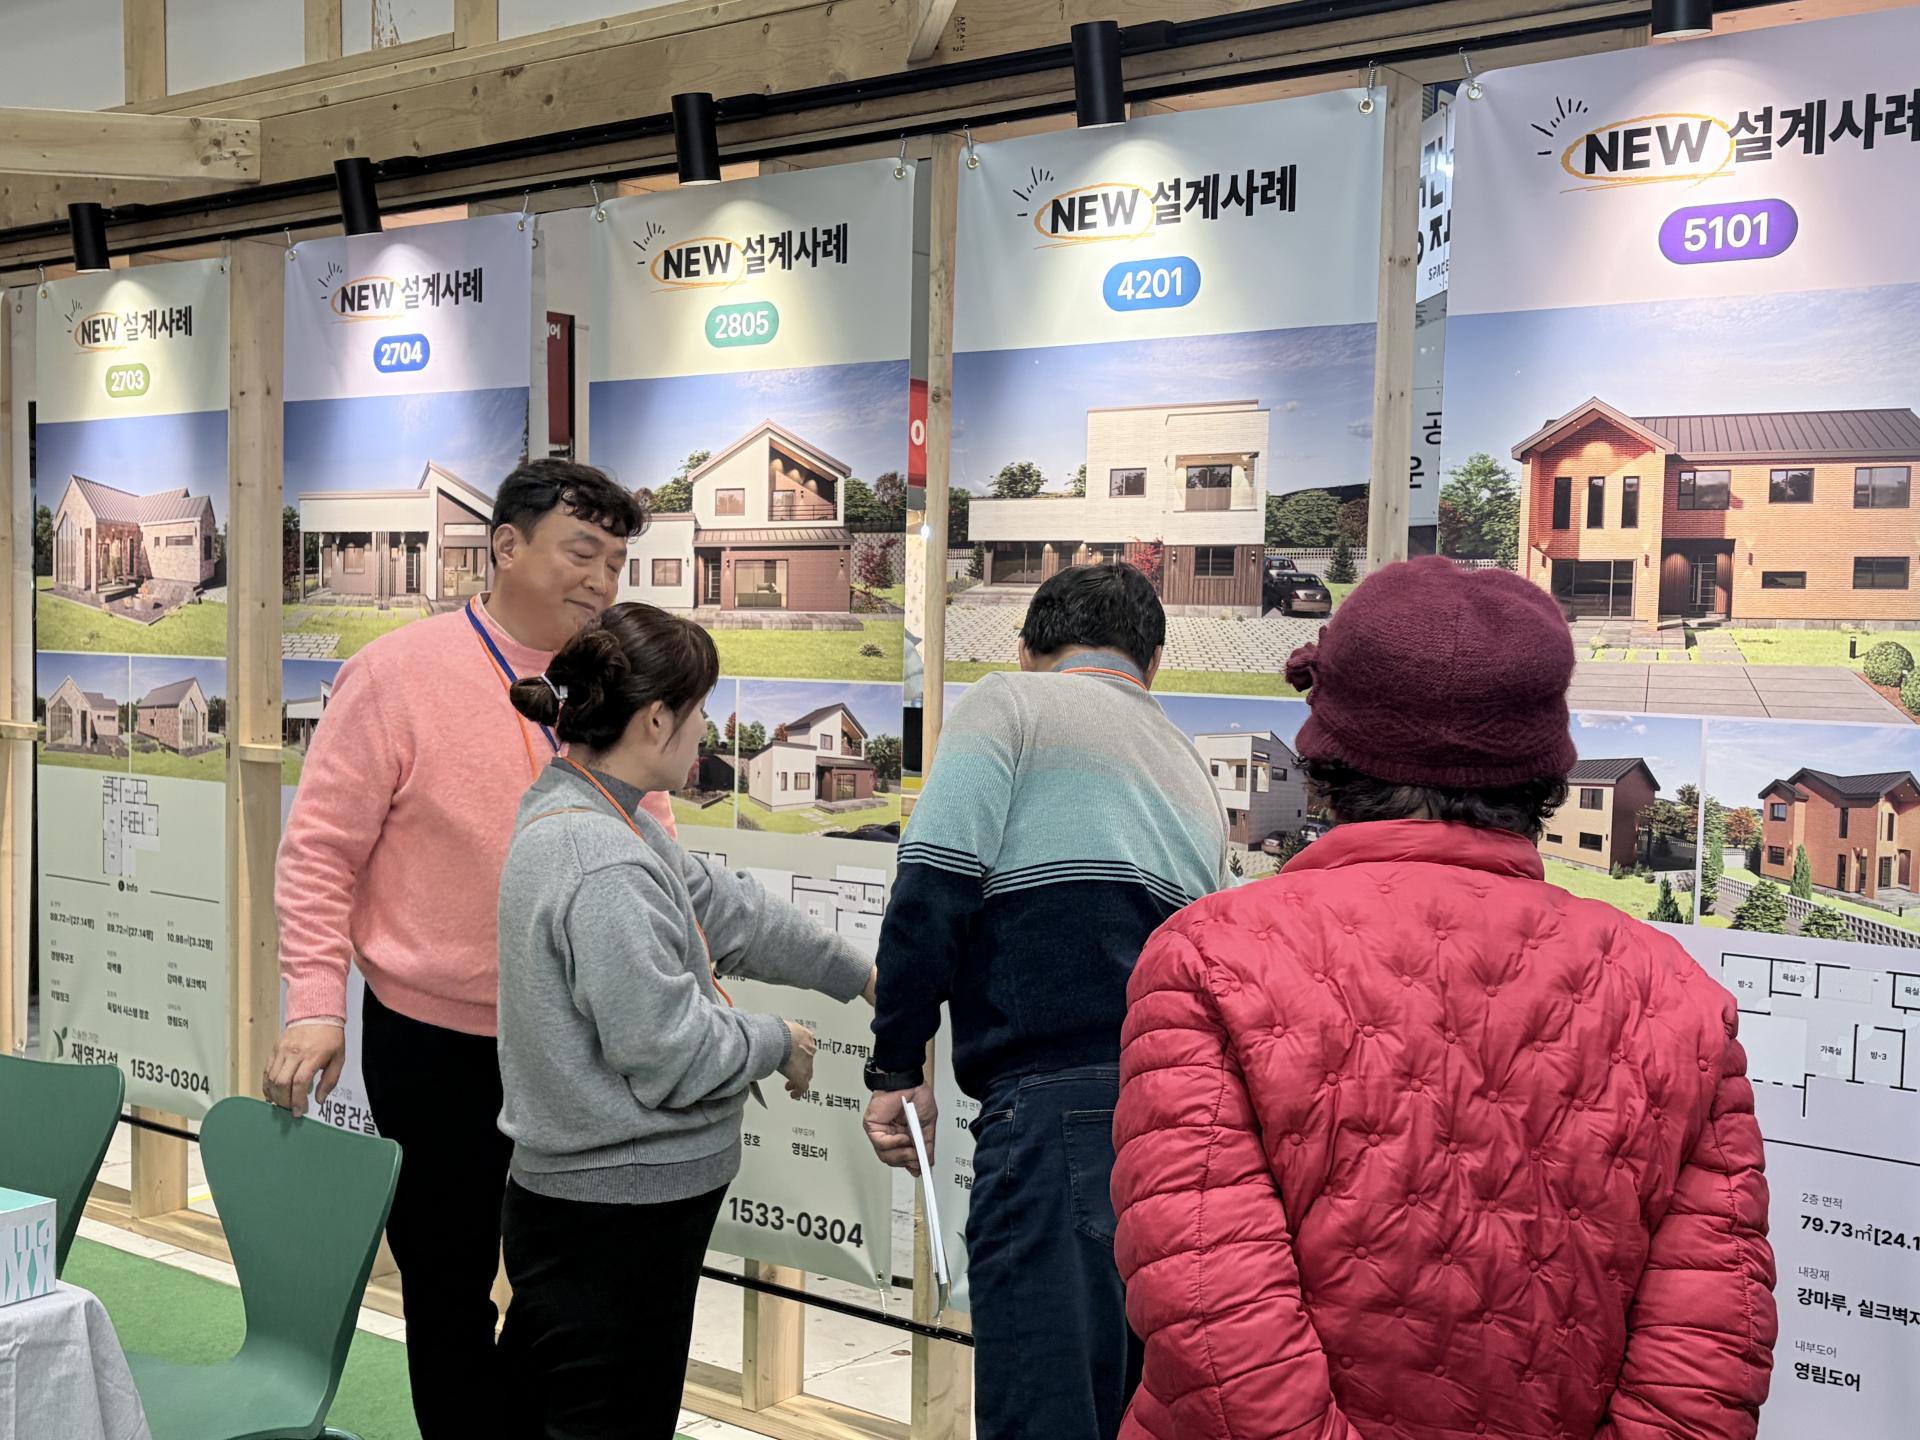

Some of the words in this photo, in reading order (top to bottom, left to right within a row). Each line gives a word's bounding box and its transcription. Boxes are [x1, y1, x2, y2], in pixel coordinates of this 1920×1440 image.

[1584, 119, 1713, 175] NEW
[1050, 188, 1140, 234] NEW
[1151, 164, 1297, 225] 설계사례
[1683, 211, 1769, 252] 5101
[663, 243, 732, 280] NEW
[742, 223, 848, 275] 설계사례
[341, 282, 394, 313] NEW
[401, 267, 482, 310] 설계사례
[1116, 266, 1183, 301] 4201
[81, 315, 119, 345] NEW
[123, 304, 193, 343] 설계사례
[714, 310, 769, 339] 2805
[379, 341, 423, 366] 2704
[110, 370, 144, 392] 2703
[1737, 979, 1754, 989] 방-2
[1820, 1045, 1843, 1057] 가족실
[1870, 1051, 1887, 1061] 방-3
[130, 1058, 210, 1095] 1533-0304
[825, 1093, 860, 1112] 실크벽지
[791, 1142, 828, 1161] 영림도어
[1801, 1192, 1819, 1206] 2층
[1822, 1195, 1843, 1210] 면적
[727, 1195, 865, 1249] 1533-0304
[1798, 1266, 1830, 1281] 내장재
[1797, 1287, 1853, 1316] 강마루,
[1795, 1339, 1838, 1358] 내부도어
[1794, 1361, 1861, 1392] 영림도어
